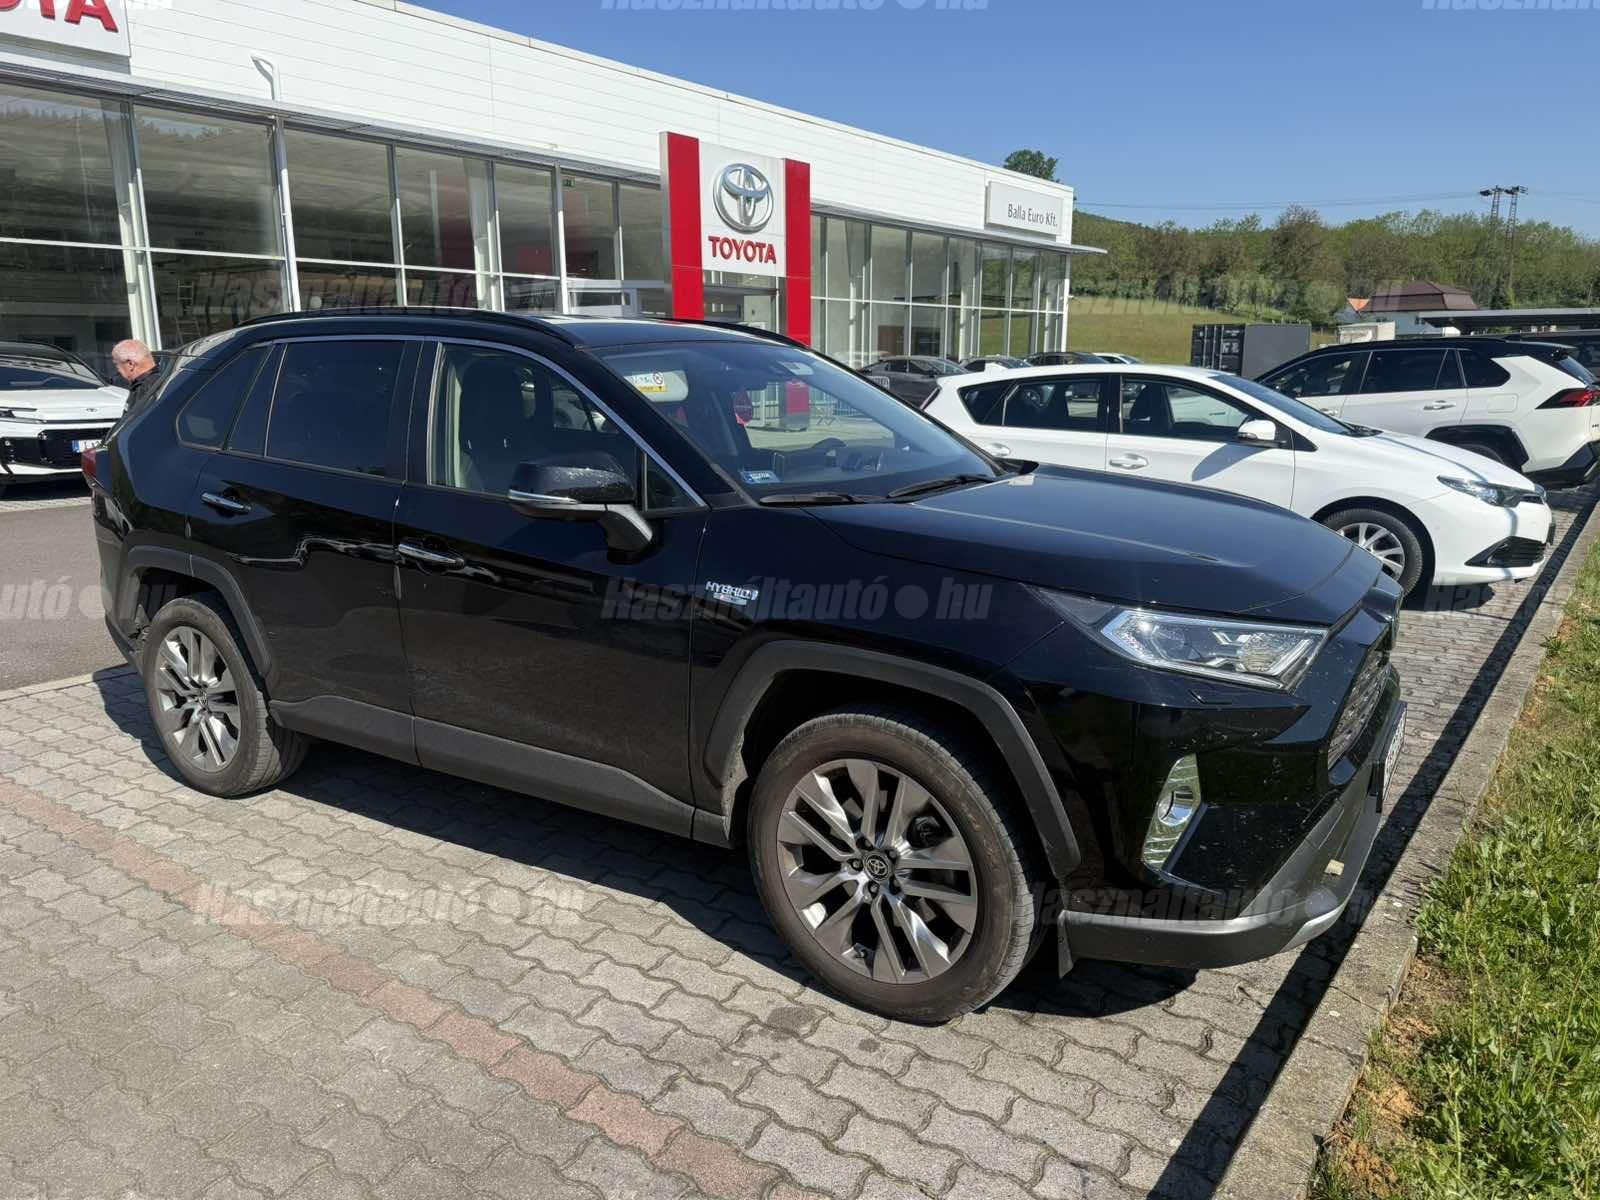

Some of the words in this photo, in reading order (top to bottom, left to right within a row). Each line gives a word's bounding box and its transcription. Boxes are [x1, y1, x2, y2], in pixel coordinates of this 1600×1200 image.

[1008, 203, 1026, 220] Balla
[1027, 208, 1044, 225] Euro
[1045, 211, 1058, 227] Kft.
[708, 236, 777, 264] TOYOTA
[705, 581, 758, 600] HYBRID
